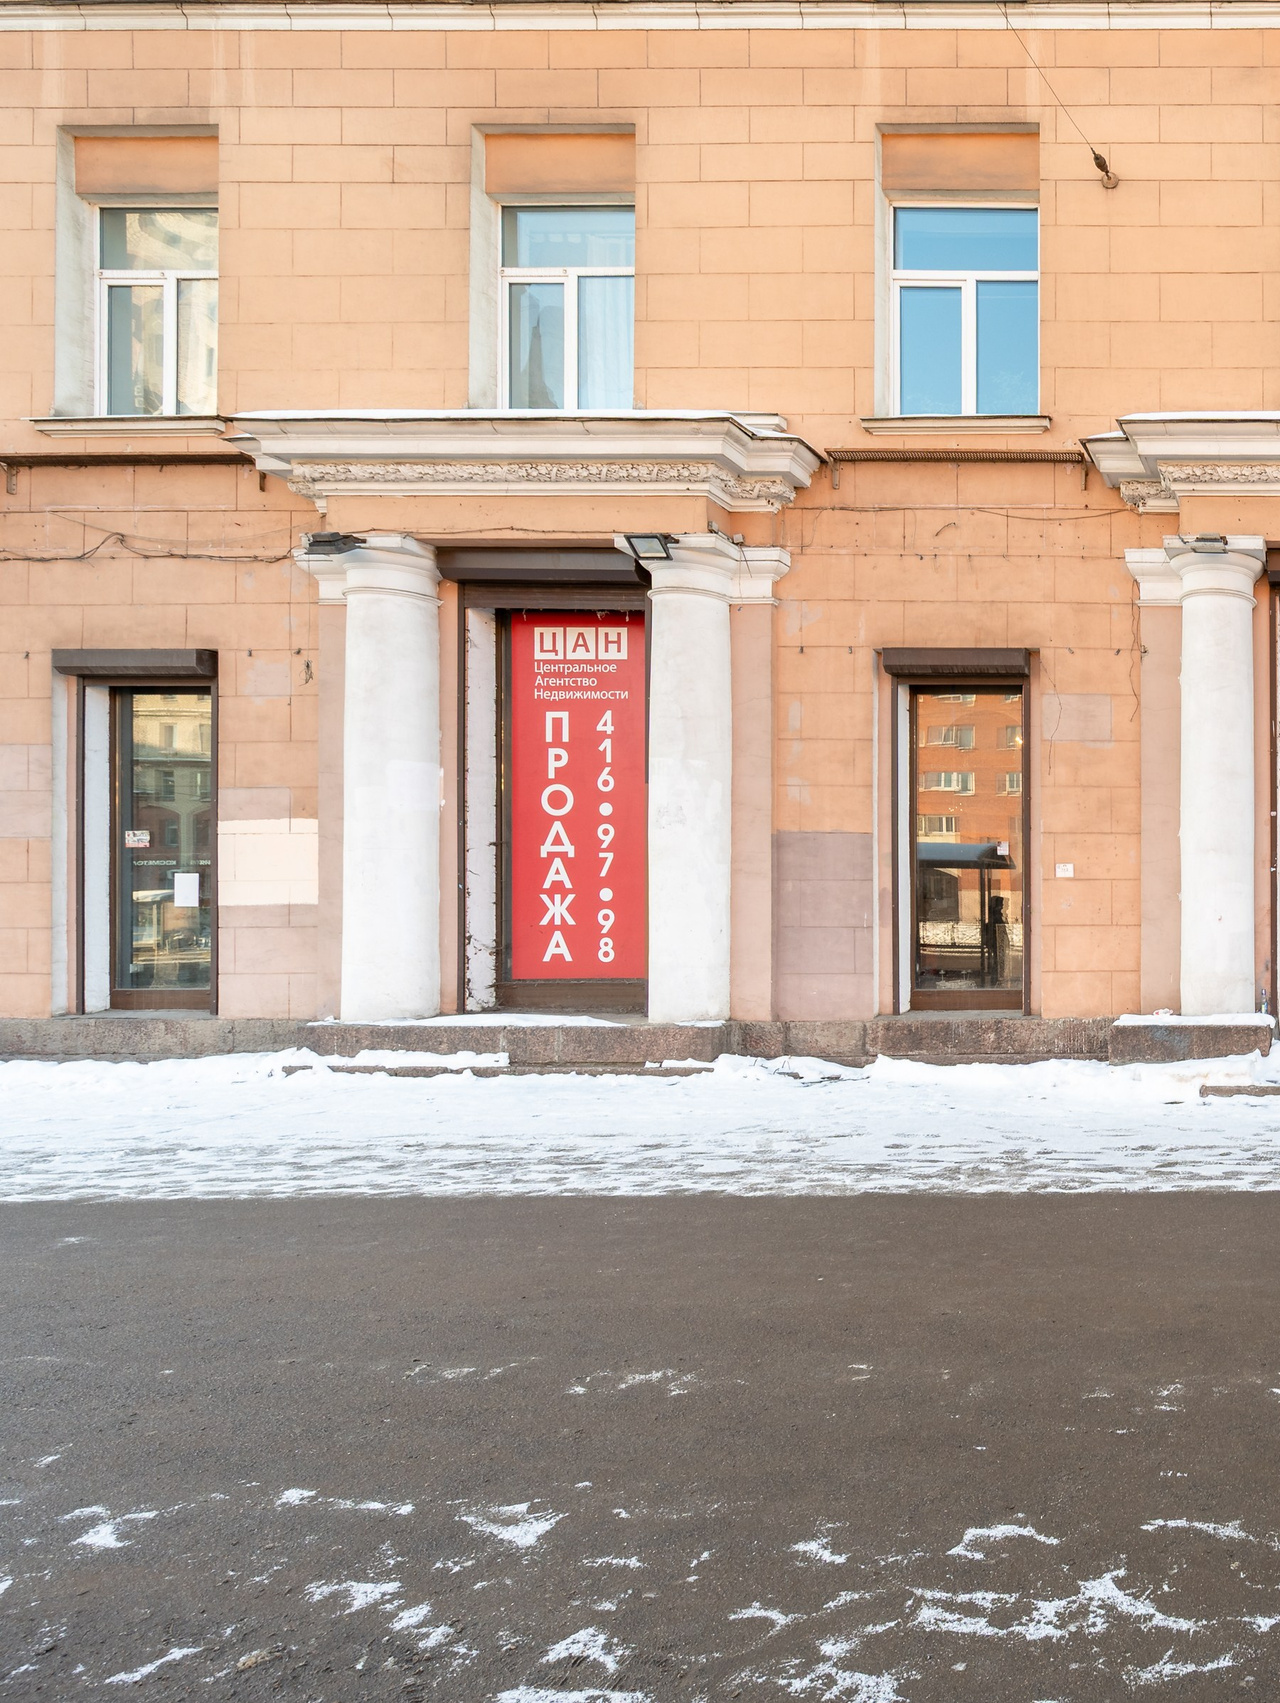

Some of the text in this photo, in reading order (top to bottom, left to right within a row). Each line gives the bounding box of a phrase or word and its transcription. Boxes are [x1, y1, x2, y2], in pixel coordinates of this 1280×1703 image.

[538, 631, 623, 657] ЦАН
[533, 661, 619, 675] Центральное
[534, 675, 598, 688] Агентство
[533, 688, 629, 702] Недвижимости
[538, 711, 577, 962] ПРОДАЖА
